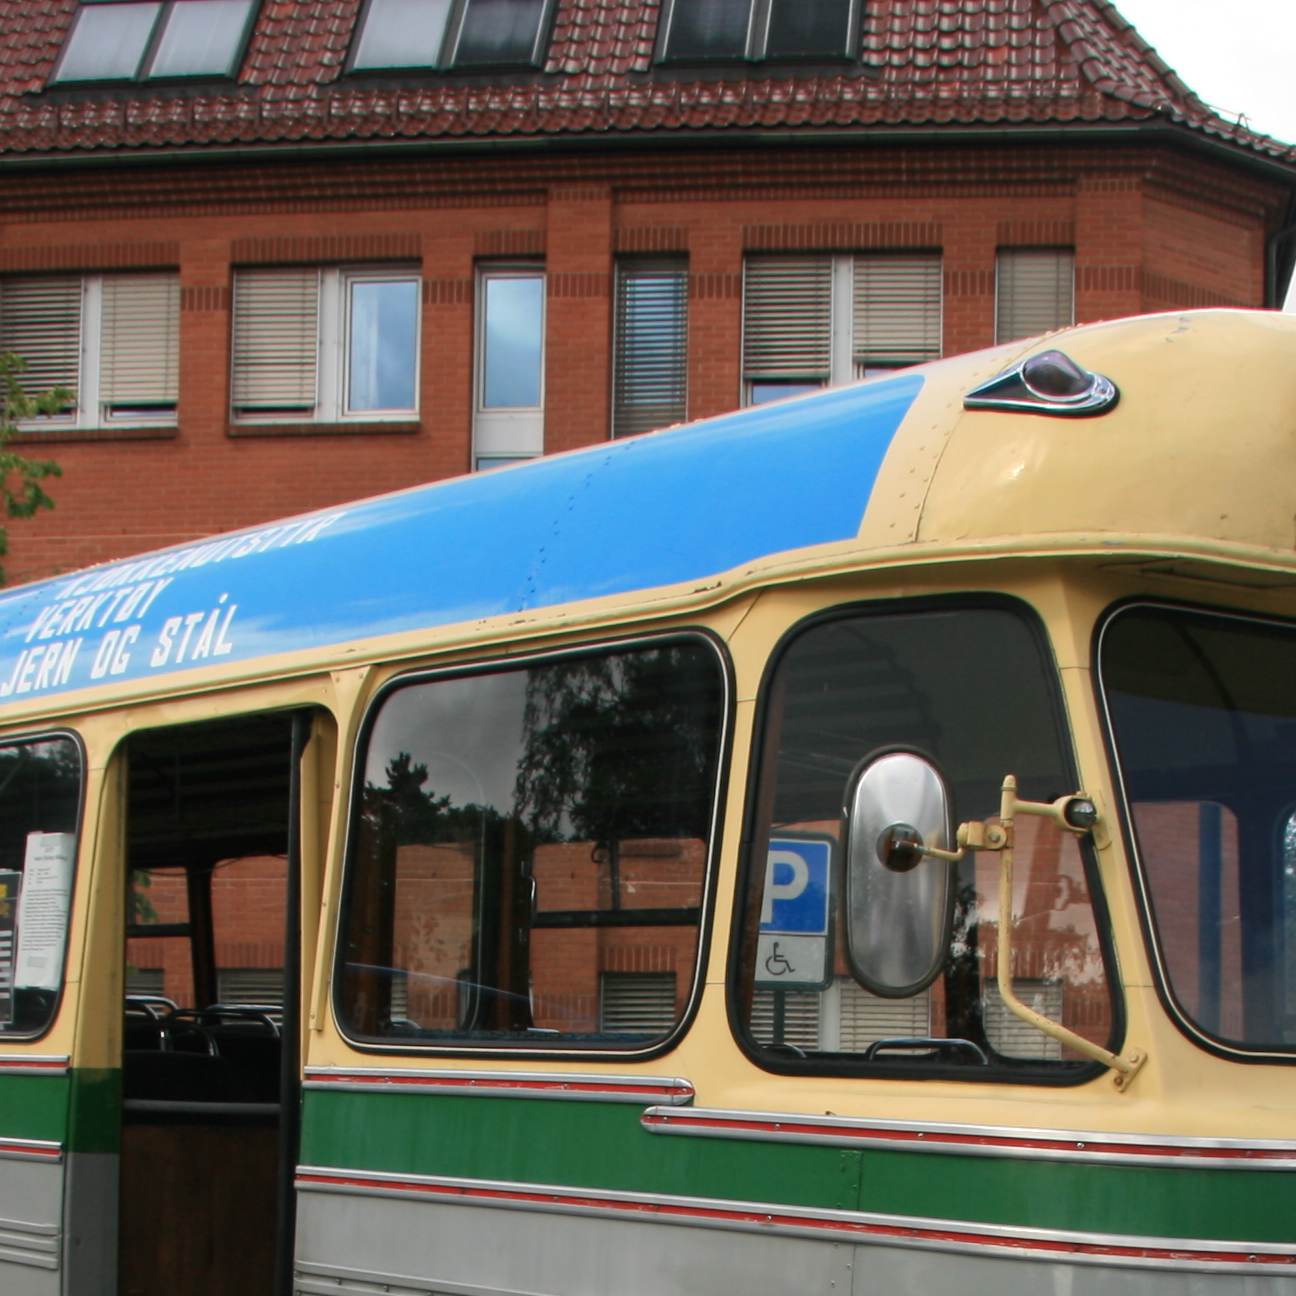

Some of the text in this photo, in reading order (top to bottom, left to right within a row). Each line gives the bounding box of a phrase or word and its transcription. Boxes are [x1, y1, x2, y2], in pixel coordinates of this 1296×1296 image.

[0, 592, 239, 697] JERN OG STÅL
[761, 850, 809, 924] P
